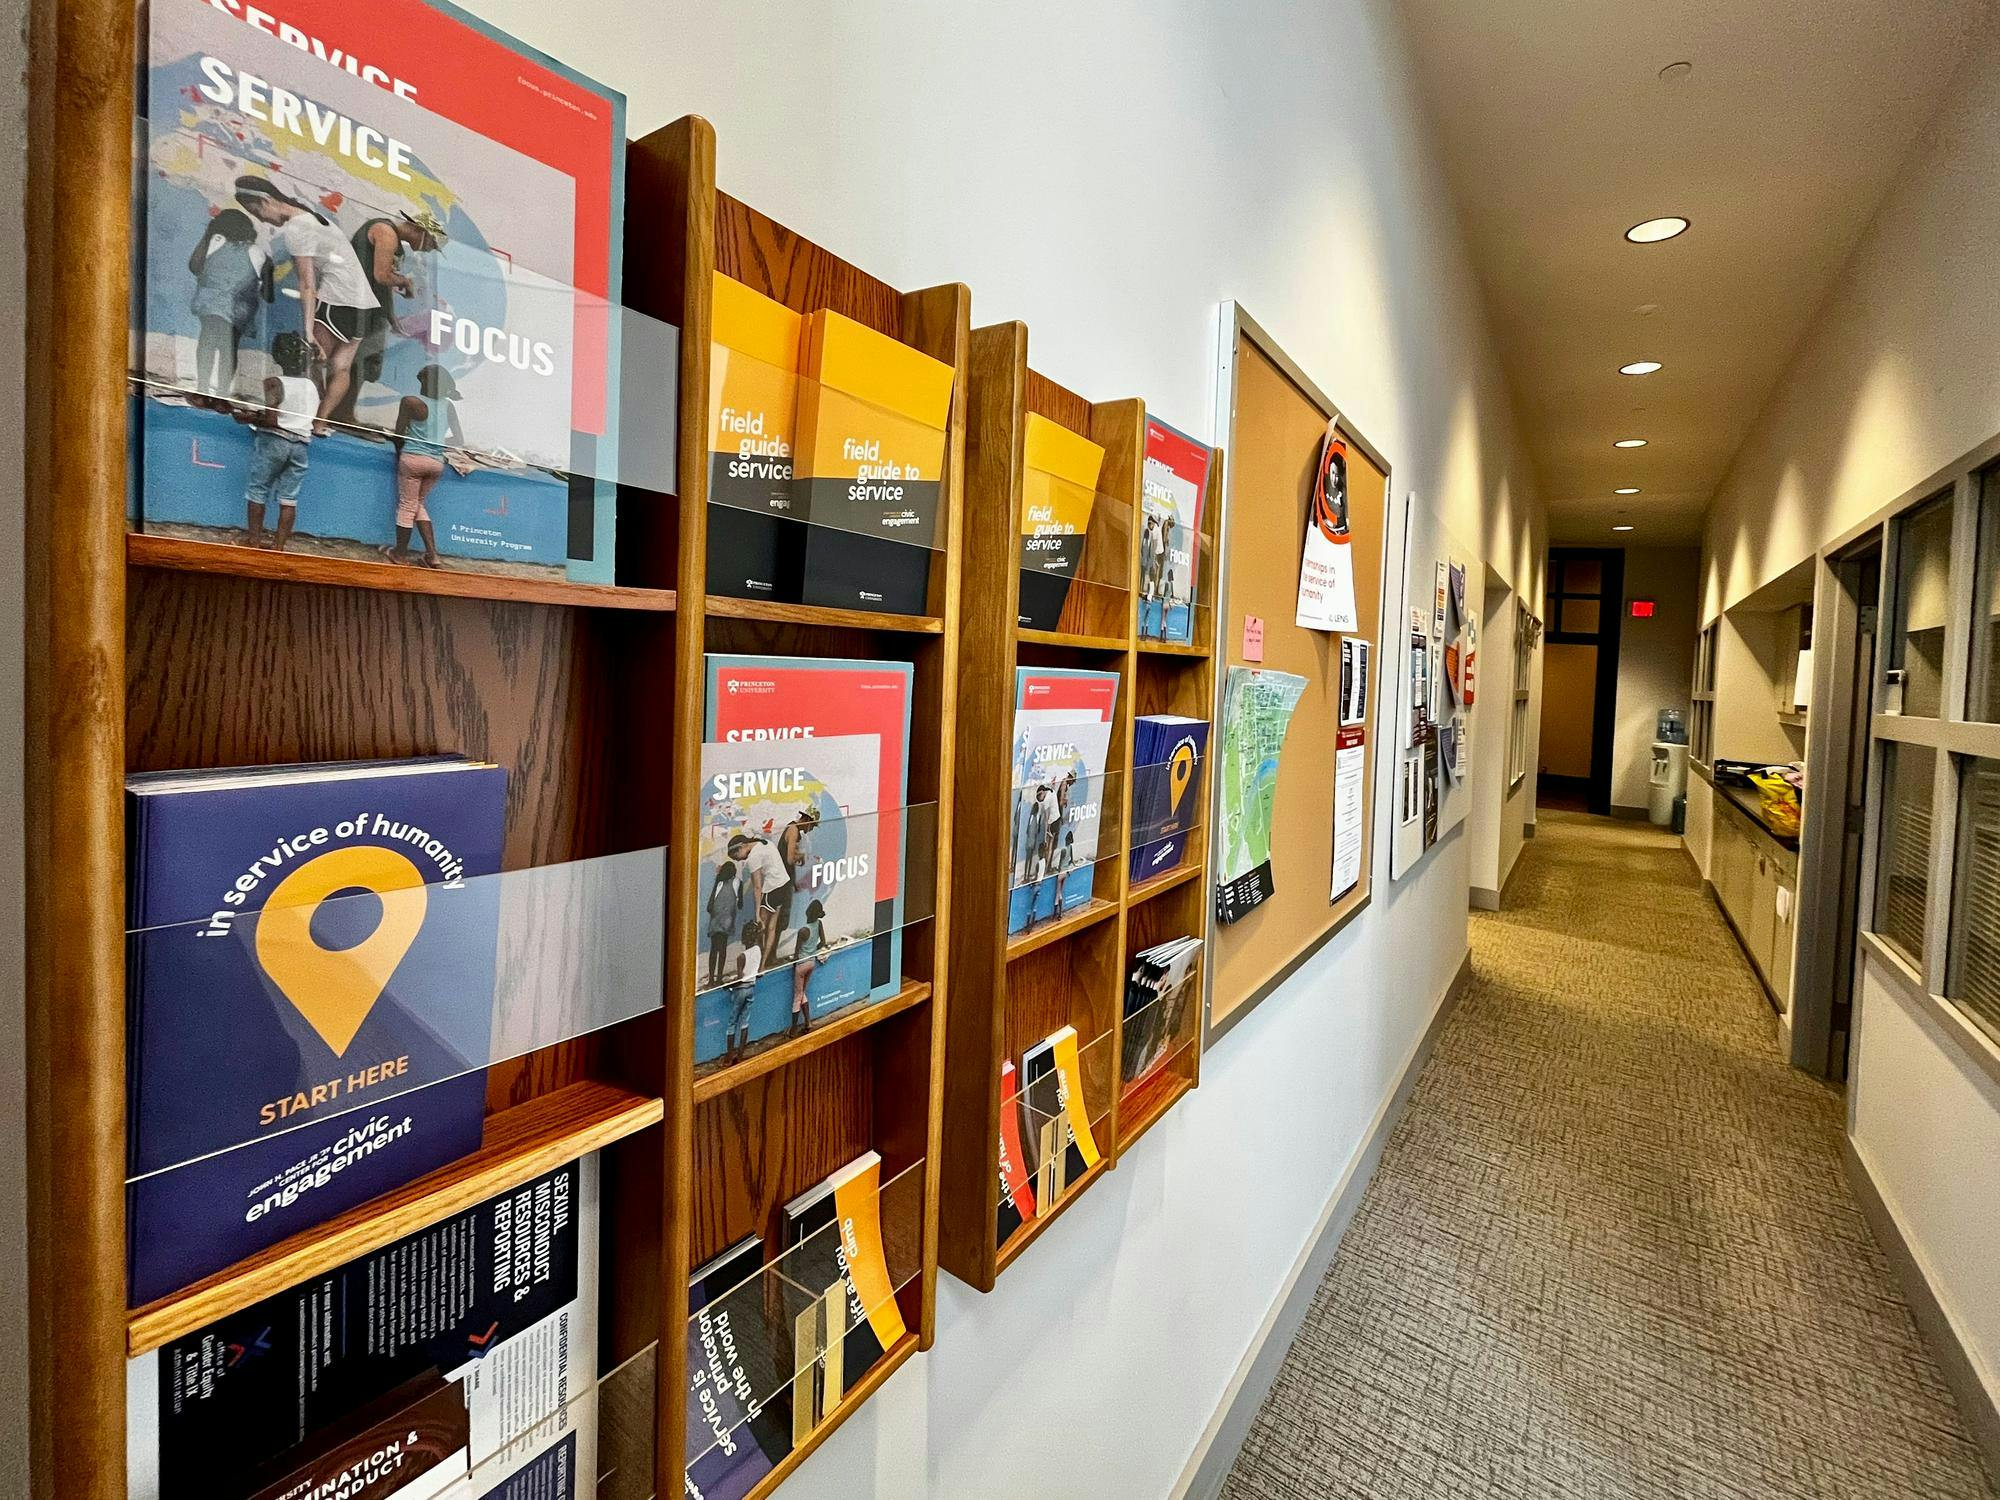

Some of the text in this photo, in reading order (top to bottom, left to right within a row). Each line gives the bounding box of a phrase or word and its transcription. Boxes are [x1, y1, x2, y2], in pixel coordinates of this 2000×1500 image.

[199, 57, 411, 182] SERVICE
[430, 309, 554, 377] FOCUS
[720, 407, 764, 435] field
[738, 434, 791, 461] guide
[842, 437, 880, 462] field
[728, 457, 793, 481] service
[857, 459, 920, 485] guide to
[848, 480, 904, 501] service
[1144, 479, 1173, 504] SERVICE
[1028, 505, 1053, 521] field
[1033, 521, 1074, 539] guide to
[451, 534, 532, 551] University Program
[460, 525, 502, 537] Princeton
[1025, 535, 1062, 551] service
[1169, 549, 1190, 567] FOCUS
[1328, 577, 1336, 588] of
[1034, 742, 1075, 763] SERVICE
[713, 767, 805, 801] SERVICE
[1068, 802, 1098, 823] FOCUS
[196, 813, 466, 937] in service of humanity
[812, 853, 869, 888] FOCUS
[259, 1055, 409, 1125] START HERE
[332, 1115, 390, 1155] civic
[246, 1116, 412, 1222] engagement
[279, 1155, 329, 1187] CENTER FOR
[248, 1178, 273, 1197] JOHN
[553, 1172, 569, 1236] SEXUAL
[493, 1199, 512, 1293] REPORTING
[513, 1189, 532, 1303] RESOURCES &
[534, 1181, 551, 1284] MISCONDUCT
[842, 1218, 858, 1258] climb
[834, 1244, 852, 1279] you
[558, 1312, 568, 1378] CONFIDENTIAL
[699, 1307, 734, 1395] princeton
[186, 1352, 199, 1398] & Title IX
[200, 1334, 215, 1399] Gender Equity
[712, 1310, 762, 1423] in the world
[690, 1369, 737, 1457] service is
[406, 1430, 419, 1446] &
[323, 1452, 405, 1500] NDUCT
[557, 1444, 568, 1495] REPORTING
